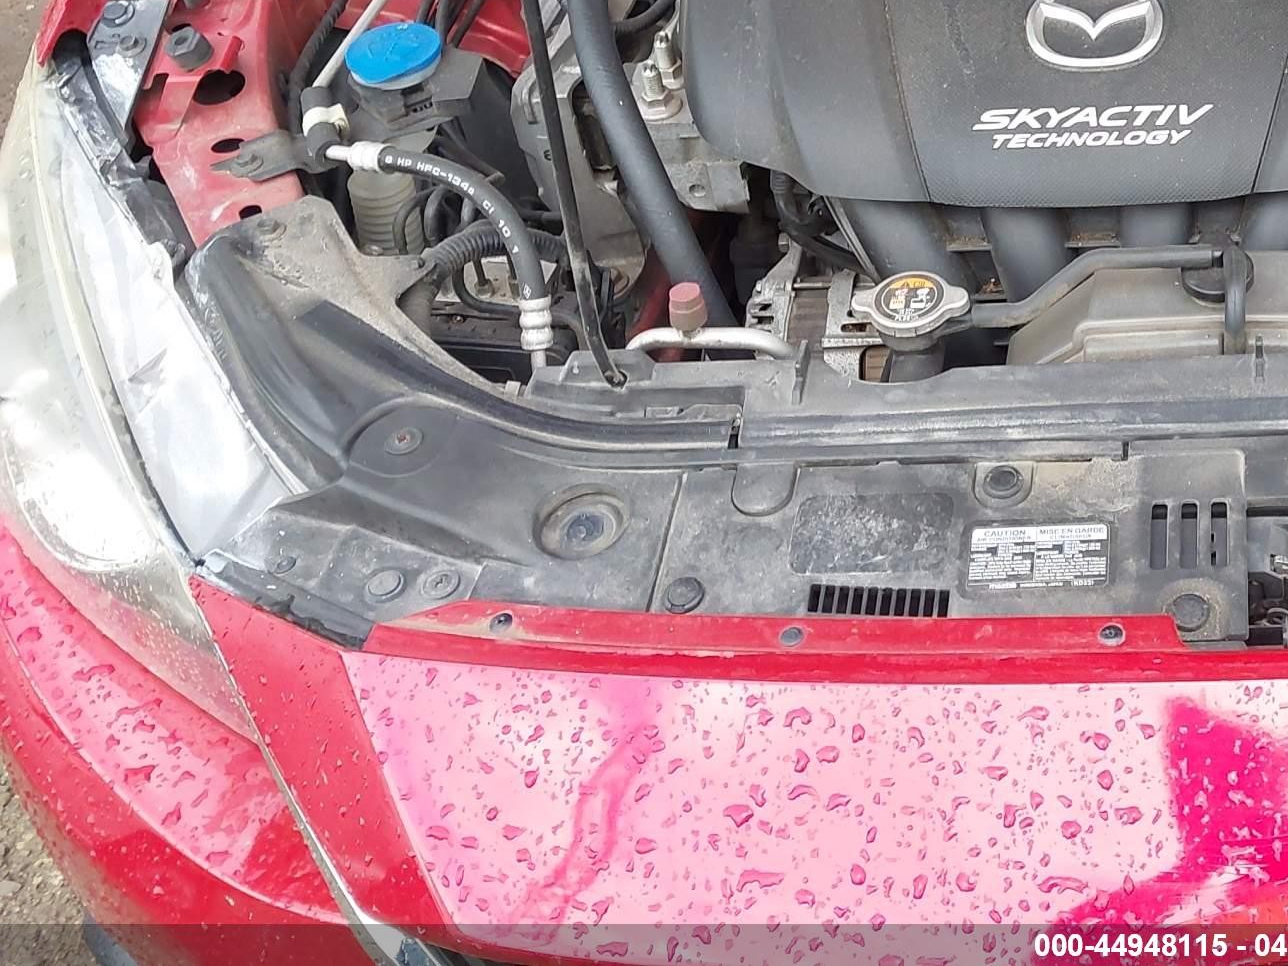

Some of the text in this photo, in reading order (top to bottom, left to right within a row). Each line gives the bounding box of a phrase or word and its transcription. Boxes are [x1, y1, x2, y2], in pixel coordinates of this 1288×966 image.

[972, 104, 1214, 130] SKYACTIV
[992, 130, 1192, 149] TECHNOLOGY
[397, 157, 412, 167] HP
[984, 530, 1026, 538] CAUTION
